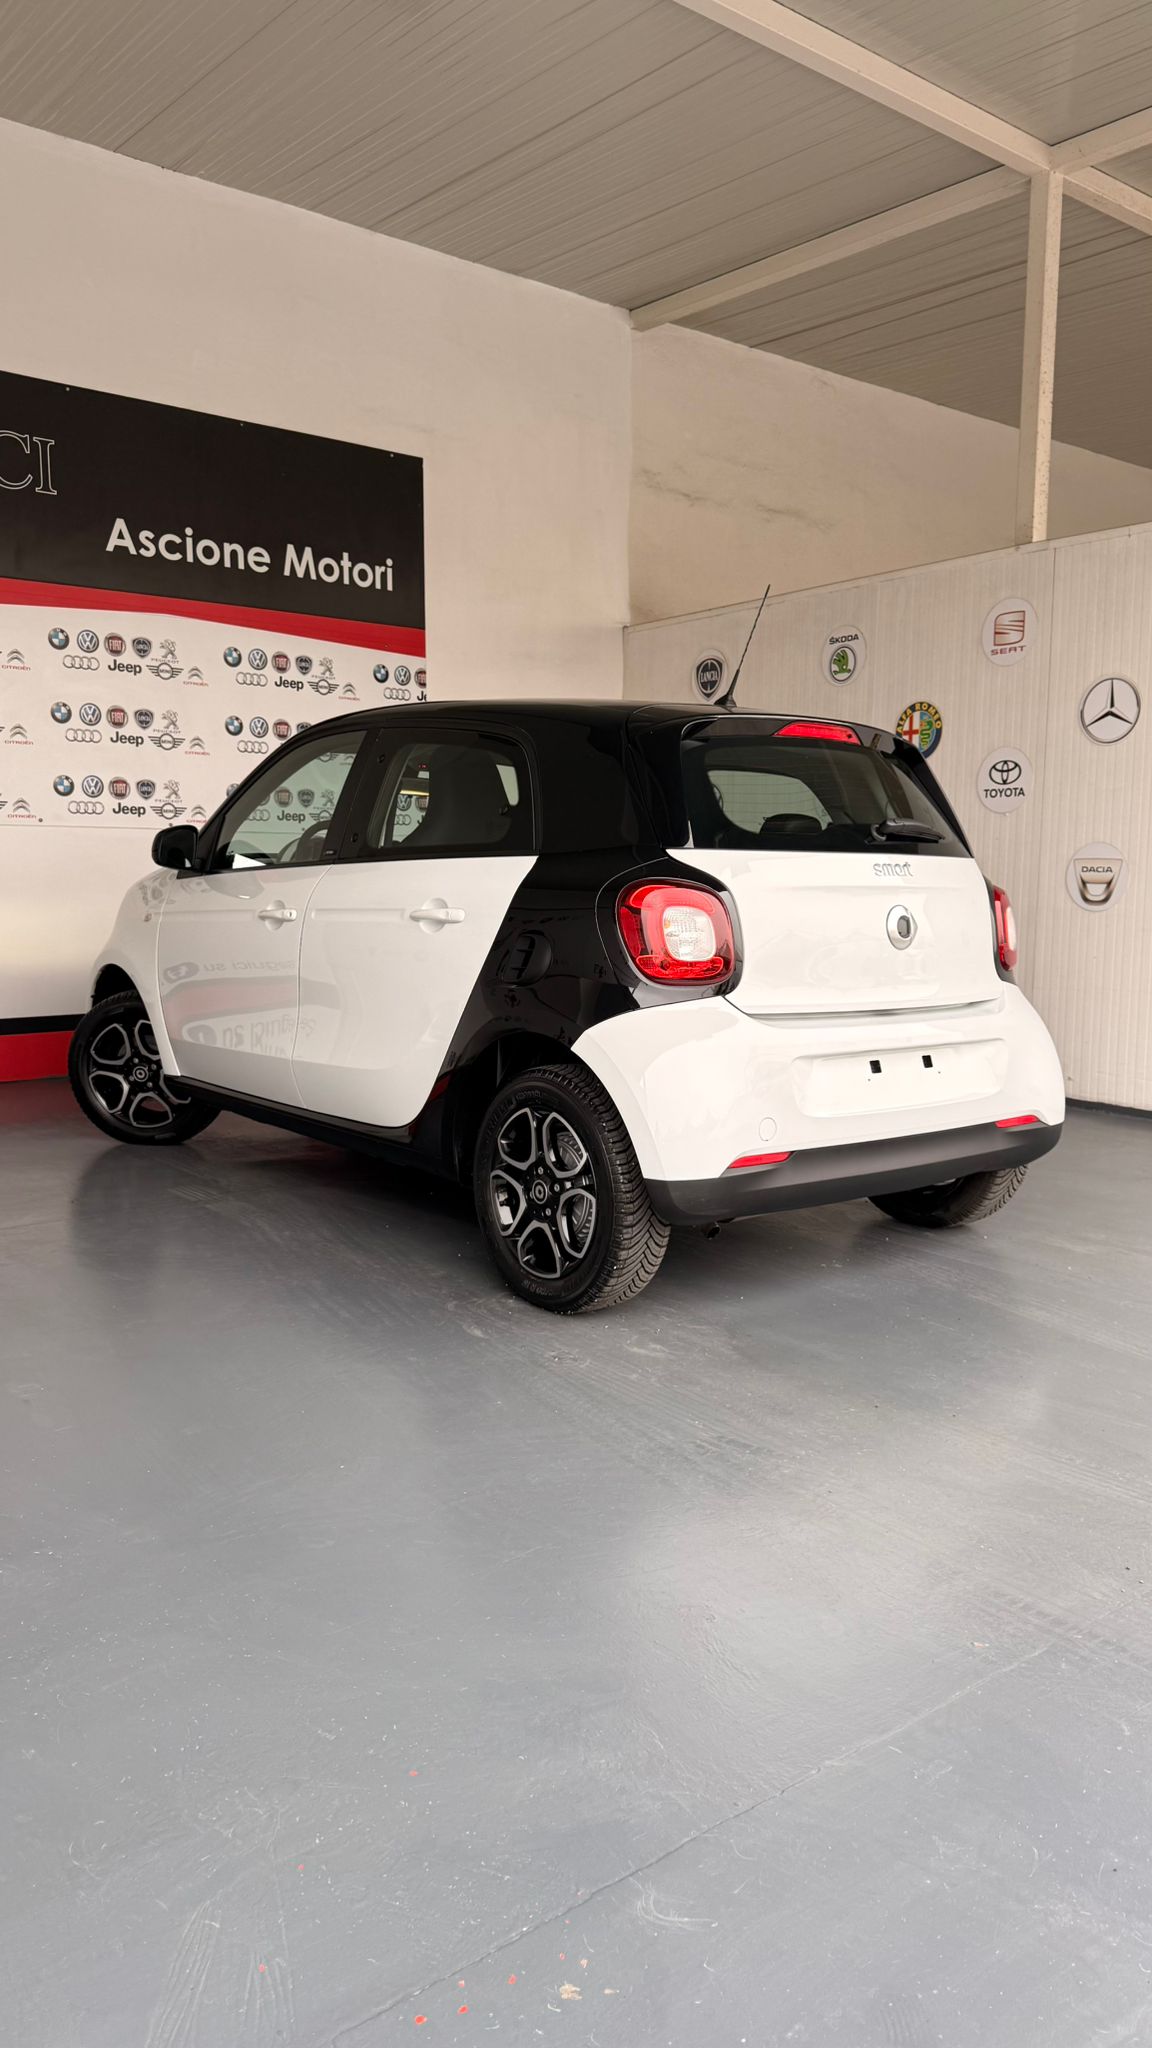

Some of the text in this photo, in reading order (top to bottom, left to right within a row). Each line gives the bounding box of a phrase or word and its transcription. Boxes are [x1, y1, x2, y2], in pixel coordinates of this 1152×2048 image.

[105, 517, 394, 591] Ascione Motori
[828, 633, 860, 645] ŠKODA
[990, 645, 1027, 656] SEAT
[107, 659, 142, 676] Jeep
[274, 676, 304, 692] Jeep
[700, 670, 718, 683] LANCIA
[896, 703, 942, 733] ALFA ROMEO
[110, 731, 144, 747] Jeep
[984, 786, 1026, 799] TOYOTA
[112, 802, 146, 818] Jeep
[276, 810, 306, 824] Jeep
[872, 862, 914, 877] smart
[1081, 864, 1113, 874] DACIA
